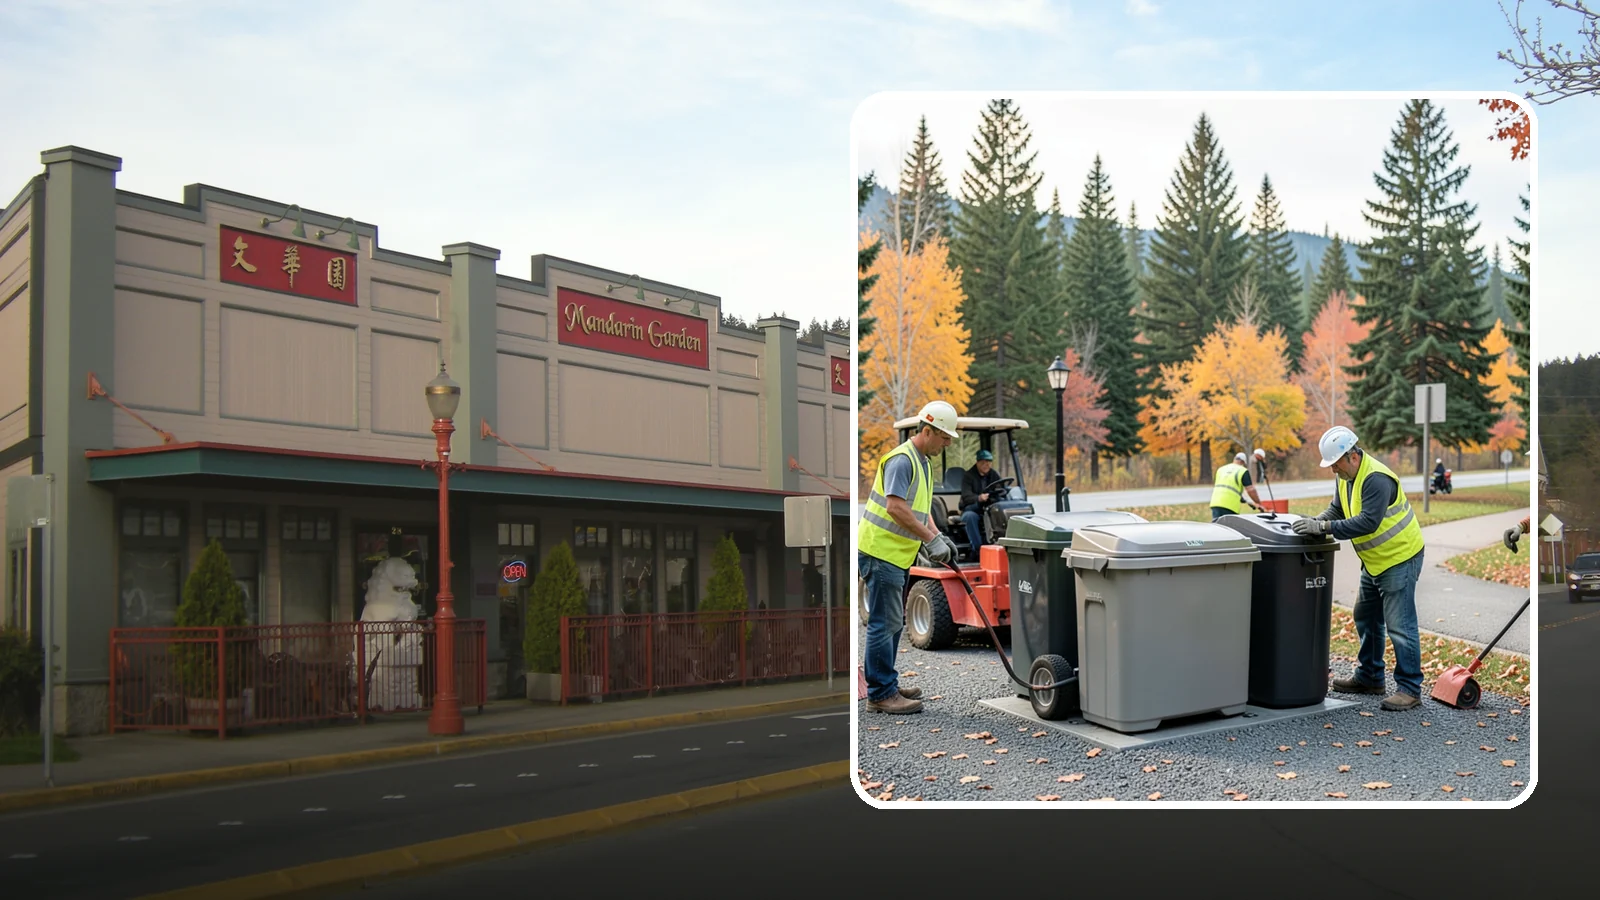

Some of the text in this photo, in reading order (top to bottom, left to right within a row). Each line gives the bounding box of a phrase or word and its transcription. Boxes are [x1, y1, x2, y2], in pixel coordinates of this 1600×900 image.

[231, 236, 346, 291] 文華園
[564, 302, 702, 352] Mandarin Garden
[503, 565, 527, 578] OPEN
